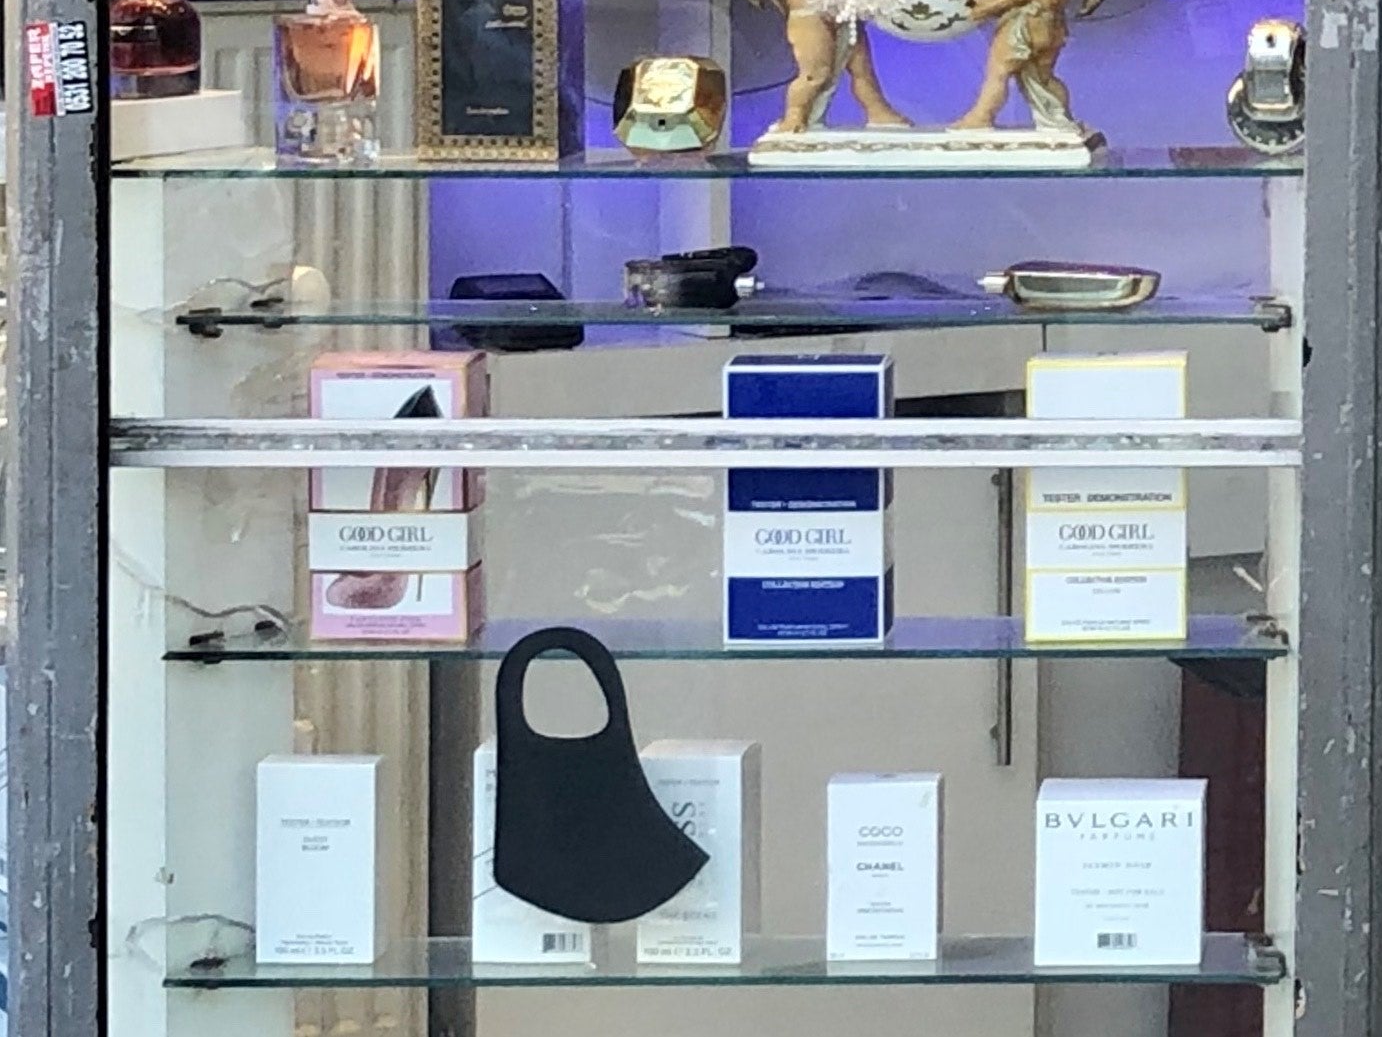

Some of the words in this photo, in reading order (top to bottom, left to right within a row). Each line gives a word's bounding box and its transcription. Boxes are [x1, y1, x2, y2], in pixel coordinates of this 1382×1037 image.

[338, 525, 385, 543] GOOD
[387, 525, 434, 543] GIRL
[755, 528, 801, 546] GOOD
[804, 528, 852, 546] GIRL
[1059, 524, 1105, 541] GOOD
[1108, 524, 1156, 541] GIRL
[1045, 811, 1193, 828] BVLGARI
[858, 826, 904, 838] COCO
[856, 862, 904, 872] CHANEL
